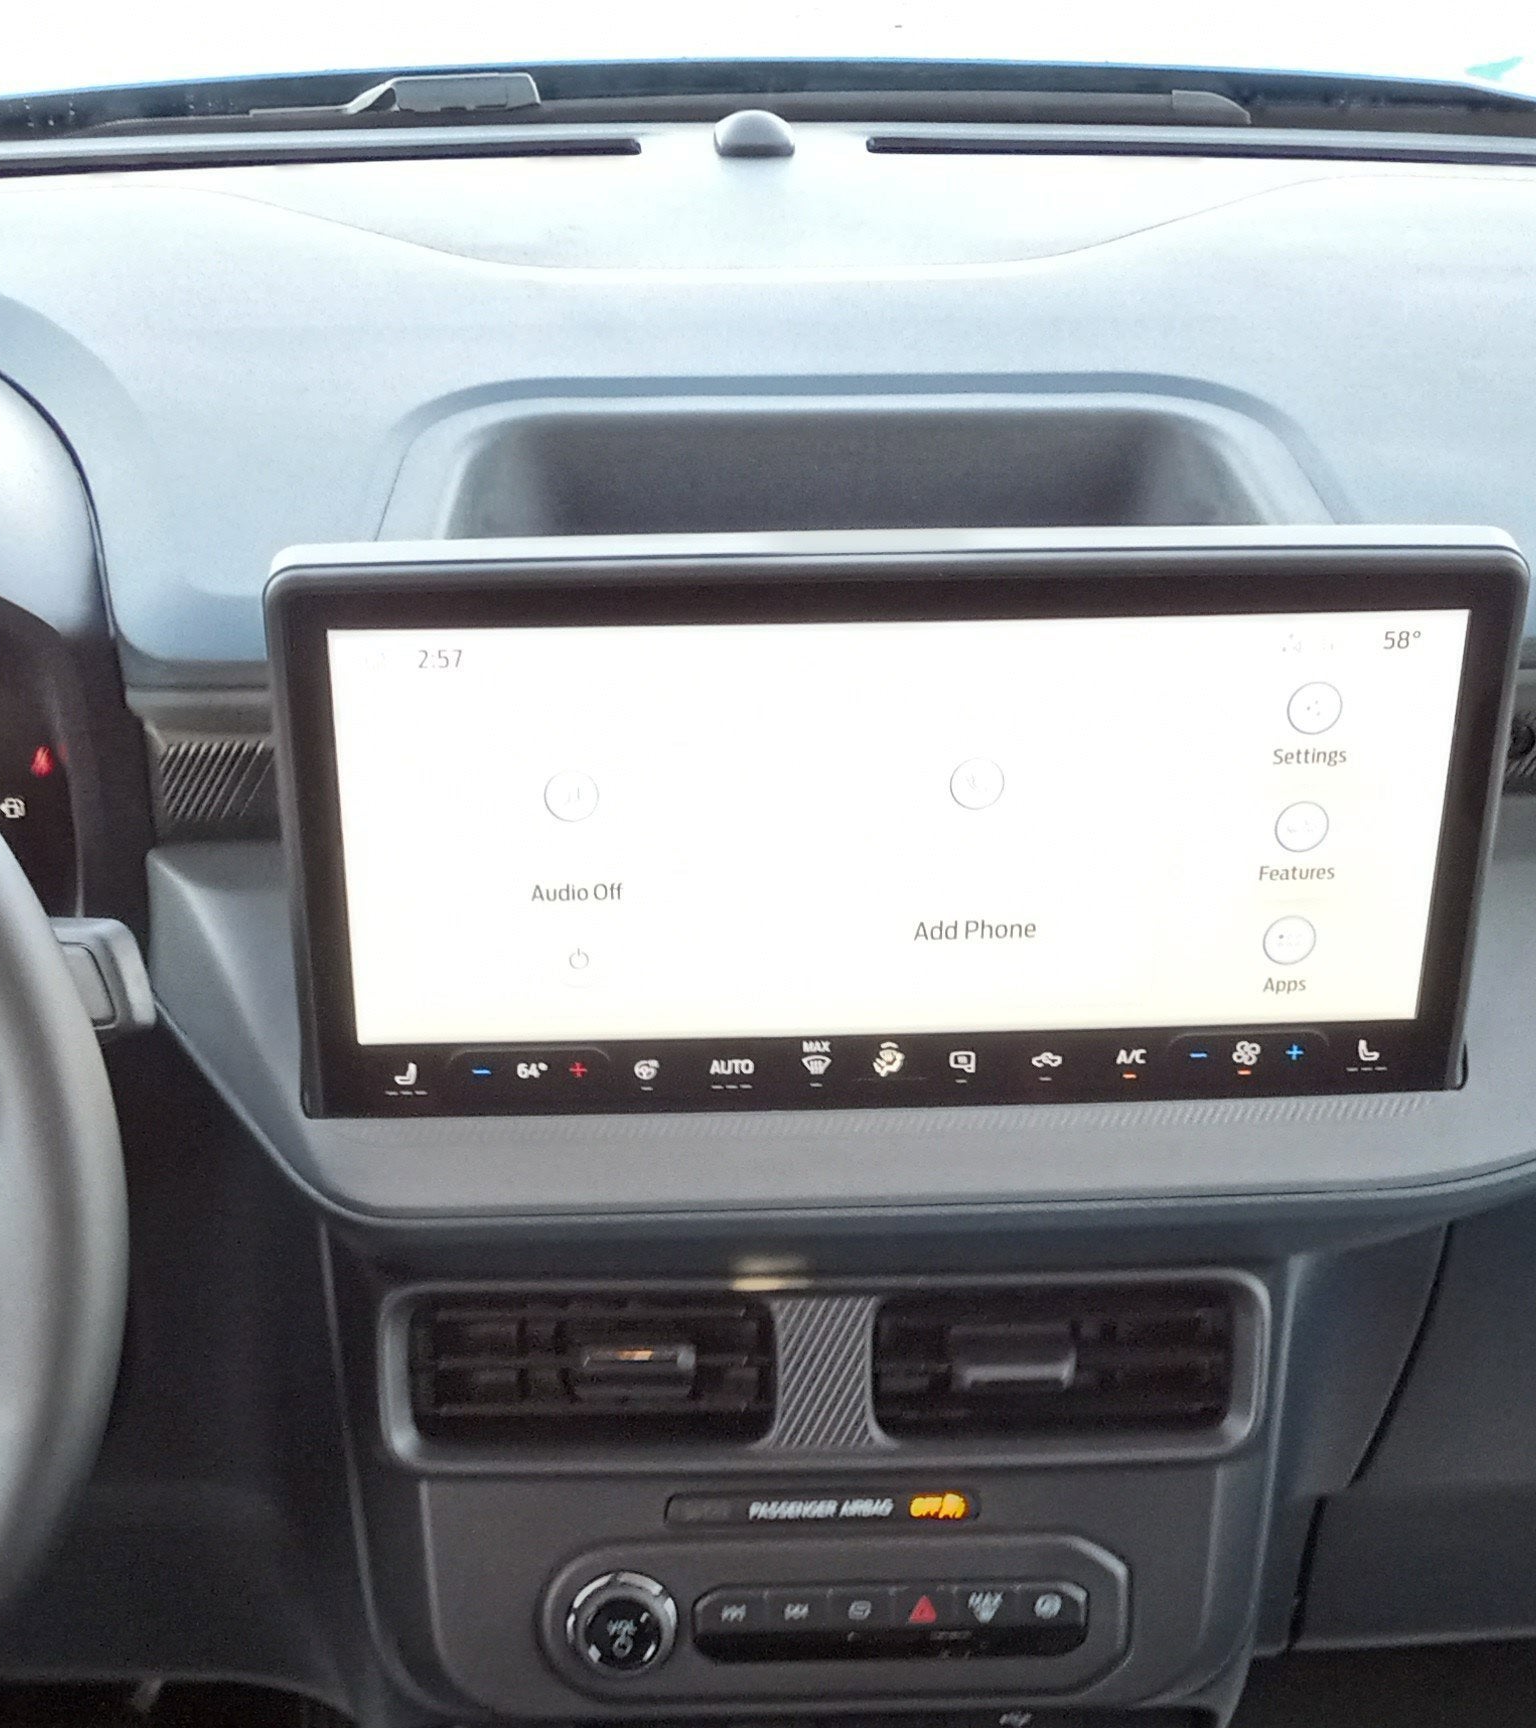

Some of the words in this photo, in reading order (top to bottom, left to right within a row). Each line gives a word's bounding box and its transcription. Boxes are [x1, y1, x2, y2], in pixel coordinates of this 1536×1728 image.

[417, 649, 463, 670] 2:57
[1272, 746, 1347, 767] Settings
[1259, 864, 1335, 881] Features
[531, 883, 589, 902] Audio
[593, 882, 623, 901] Off
[913, 920, 958, 941] Add
[964, 919, 1037, 940] Phone
[1263, 977, 1306, 995] Apps
[802, 1041, 831, 1053] MAX
[1116, 1048, 1147, 1065] A/C
[710, 1058, 754, 1076] AUTO
[749, 1500, 838, 1520] PASSENGER
[839, 1498, 894, 1518] AIRBAG
